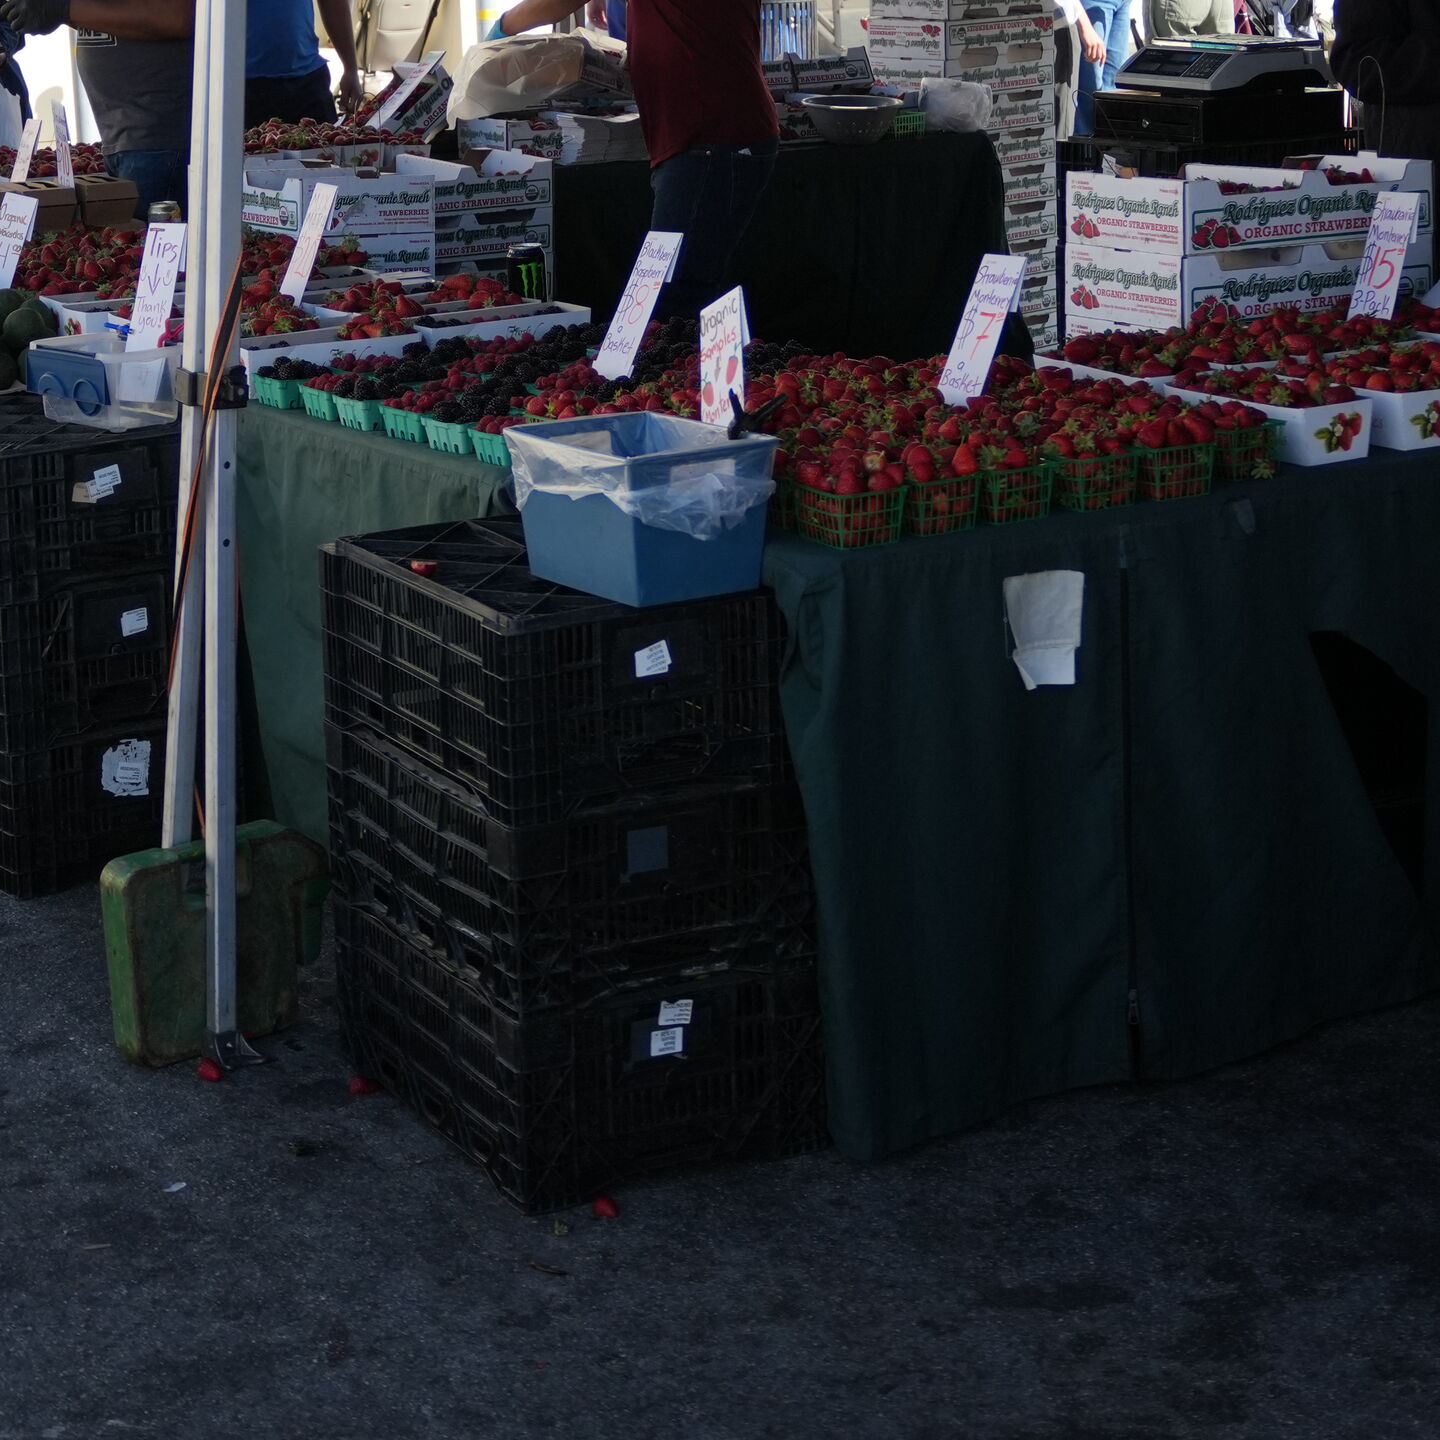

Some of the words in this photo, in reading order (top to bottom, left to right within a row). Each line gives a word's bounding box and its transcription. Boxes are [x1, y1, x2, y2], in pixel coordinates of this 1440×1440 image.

[400, 189, 430, 206] Ranch
[456, 181, 495, 200] Organic
[496, 175, 528, 197] Ranch
[378, 208, 430, 218] TRAWBERRIES
[461, 194, 525, 209] STRAWBERRIES
[1072, 191, 1115, 214] Rodriguez
[1117, 196, 1149, 218] Organic
[1150, 199, 1179, 218] Ranch
[1220, 196, 1296, 227] Rodriguez
[1298, 193, 1352, 222] Organic
[0, 203, 27, 230] Organic
[1096, 217, 1127, 229] ORGANIC
[1128, 220, 1179, 234] STRAWBERRIES
[1244, 225, 1302, 240] ORGANIC
[149, 227, 178, 264] Tips
[400, 247, 430, 265] Ranch
[1071, 262, 1114, 287] Rodriguez
[1116, 266, 1150, 290] Organic
[1150, 272, 1178, 291] Ranch
[1219, 273, 1294, 305] Rodriguez
[1296, 265, 1351, 295] Organic
[137, 296, 167, 317] Thank
[1096, 288, 1127, 301] ORGANIC
[1128, 292, 1178, 306] STRAWBERRIES
[1350, 289, 1391, 314] 3-Pack
[137, 315, 163, 335] you!
[699, 298, 738, 342] Organic
[602, 332, 635, 356] Basket
[700, 327, 737, 360] Samples
[940, 368, 982, 395] Basket
